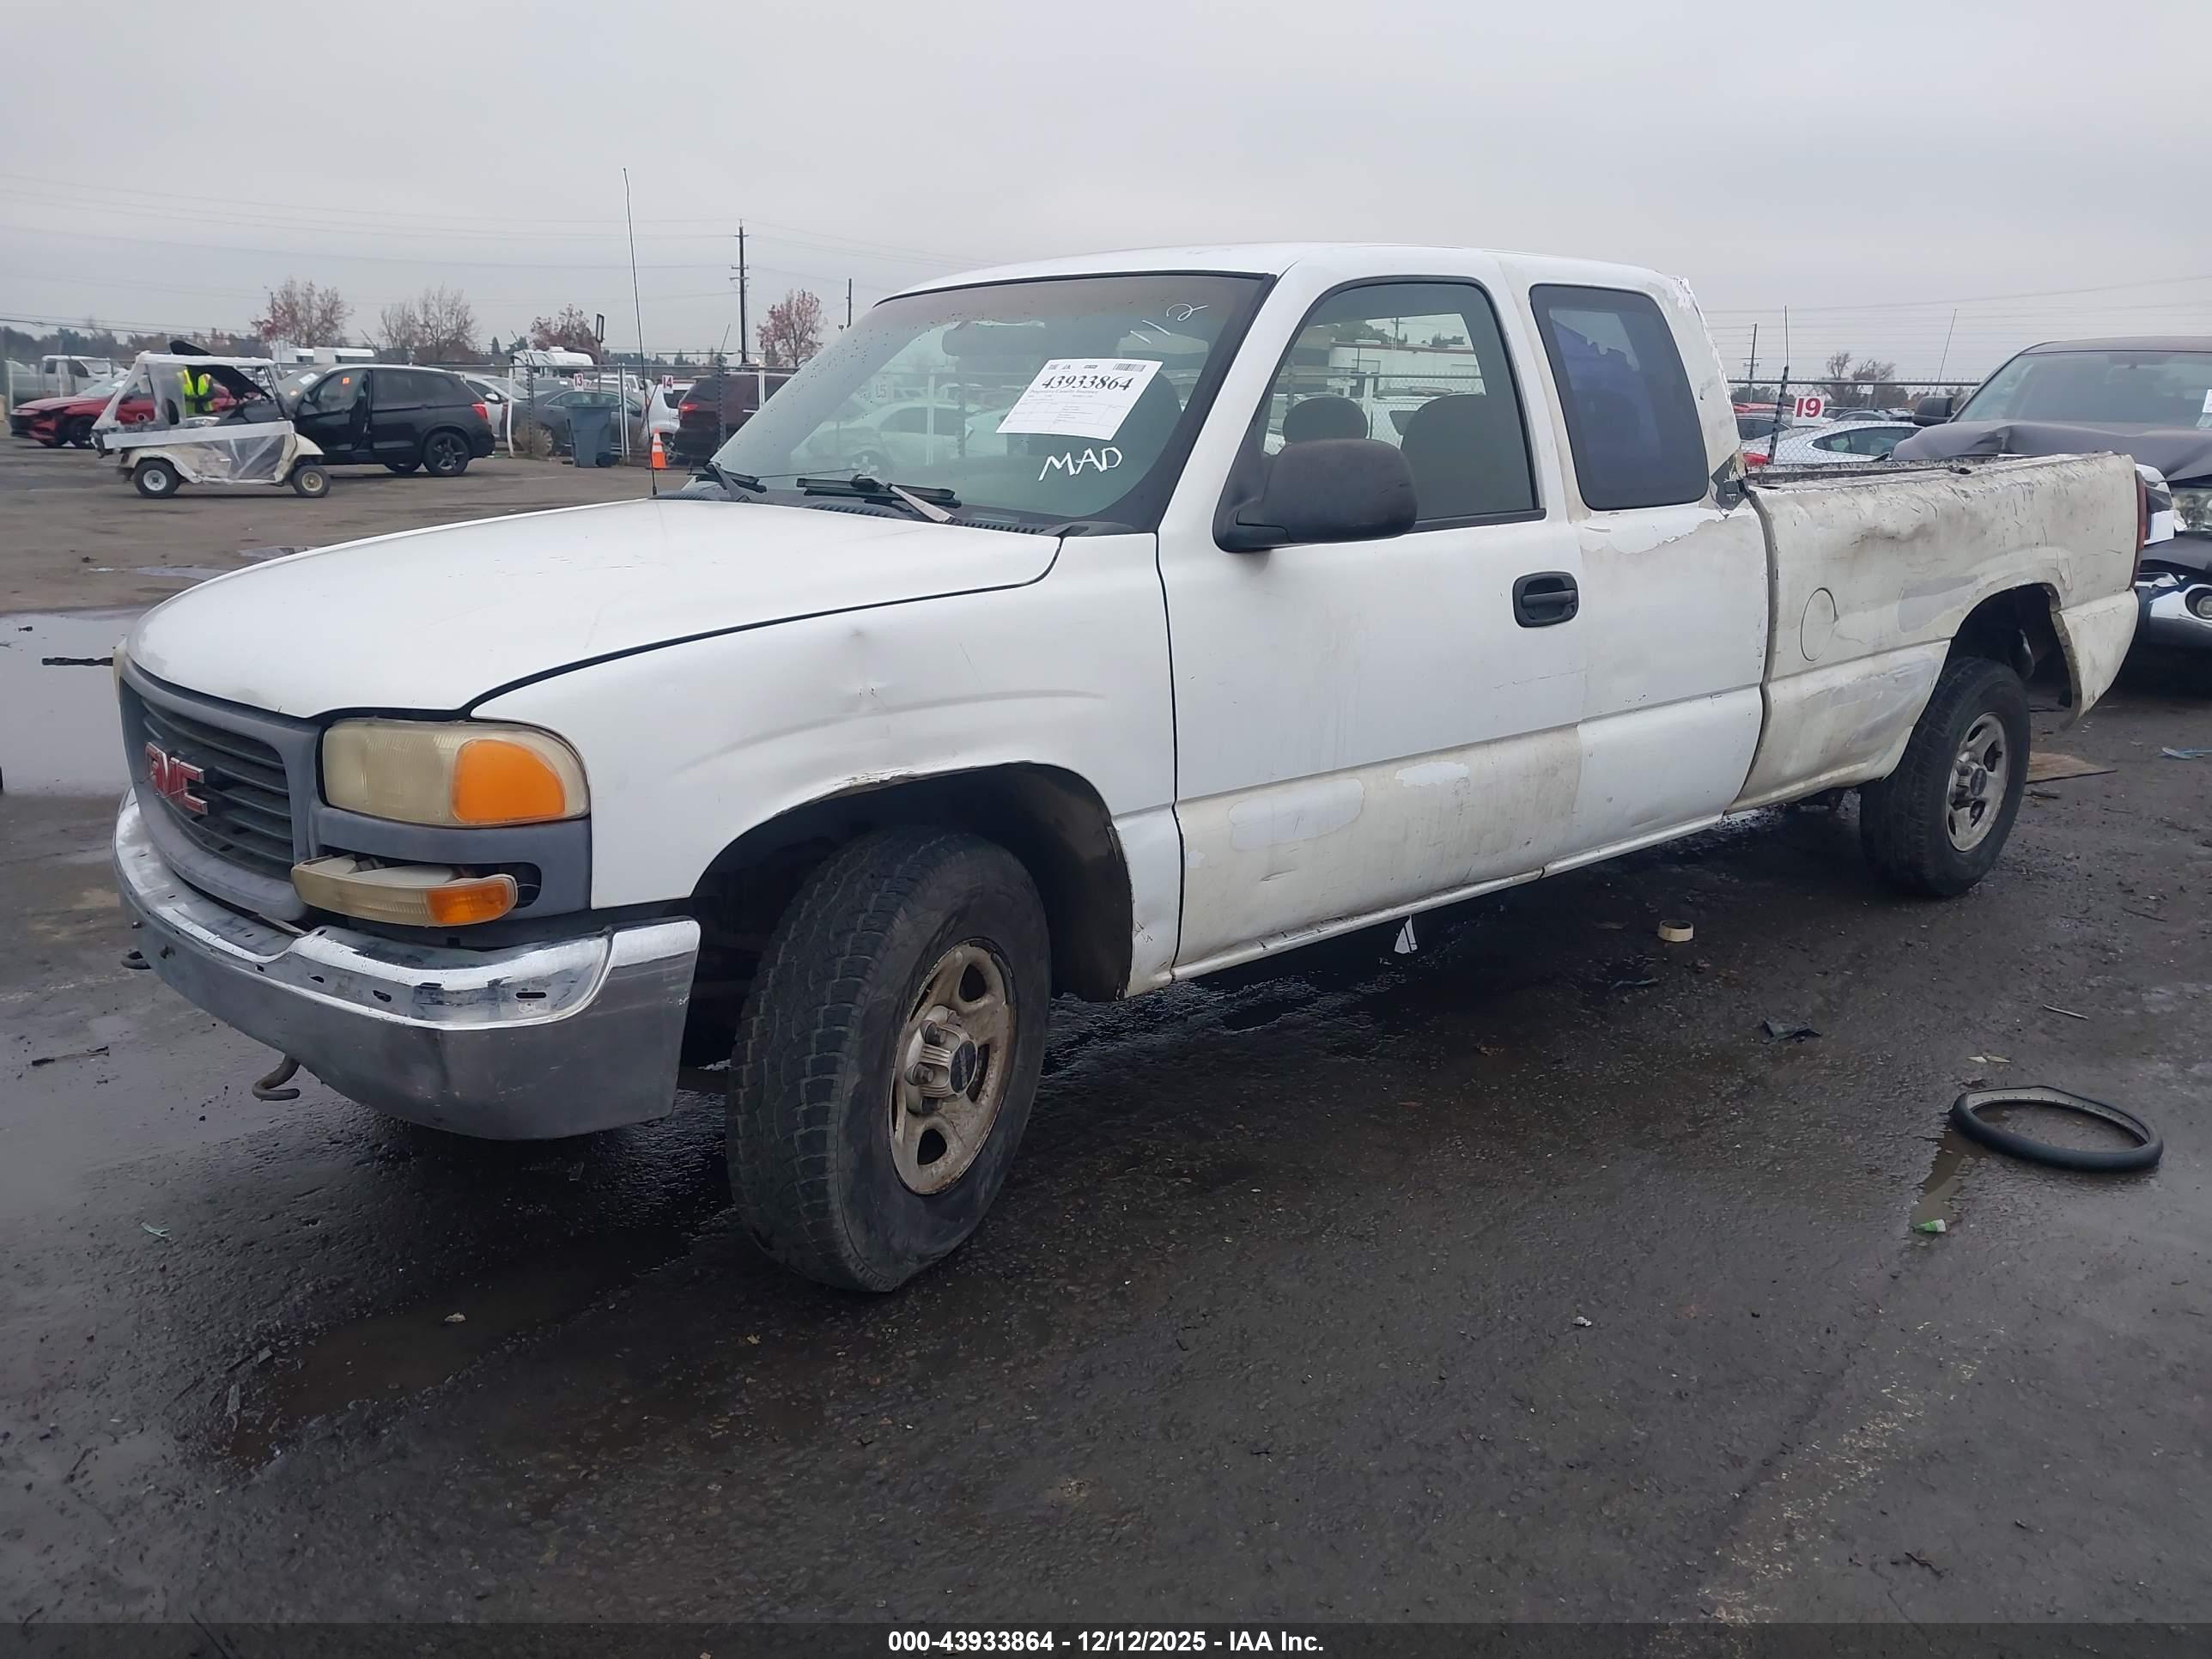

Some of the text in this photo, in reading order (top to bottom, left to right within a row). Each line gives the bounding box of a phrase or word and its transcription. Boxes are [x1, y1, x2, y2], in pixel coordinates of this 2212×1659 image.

[574, 374, 583, 386] 13
[663, 376, 672, 389] 14
[1042, 375, 1134, 391] 43933864
[1796, 398, 1821, 418] 19
[1037, 447, 1123, 482] MAD
[145, 741, 209, 815] GMC
